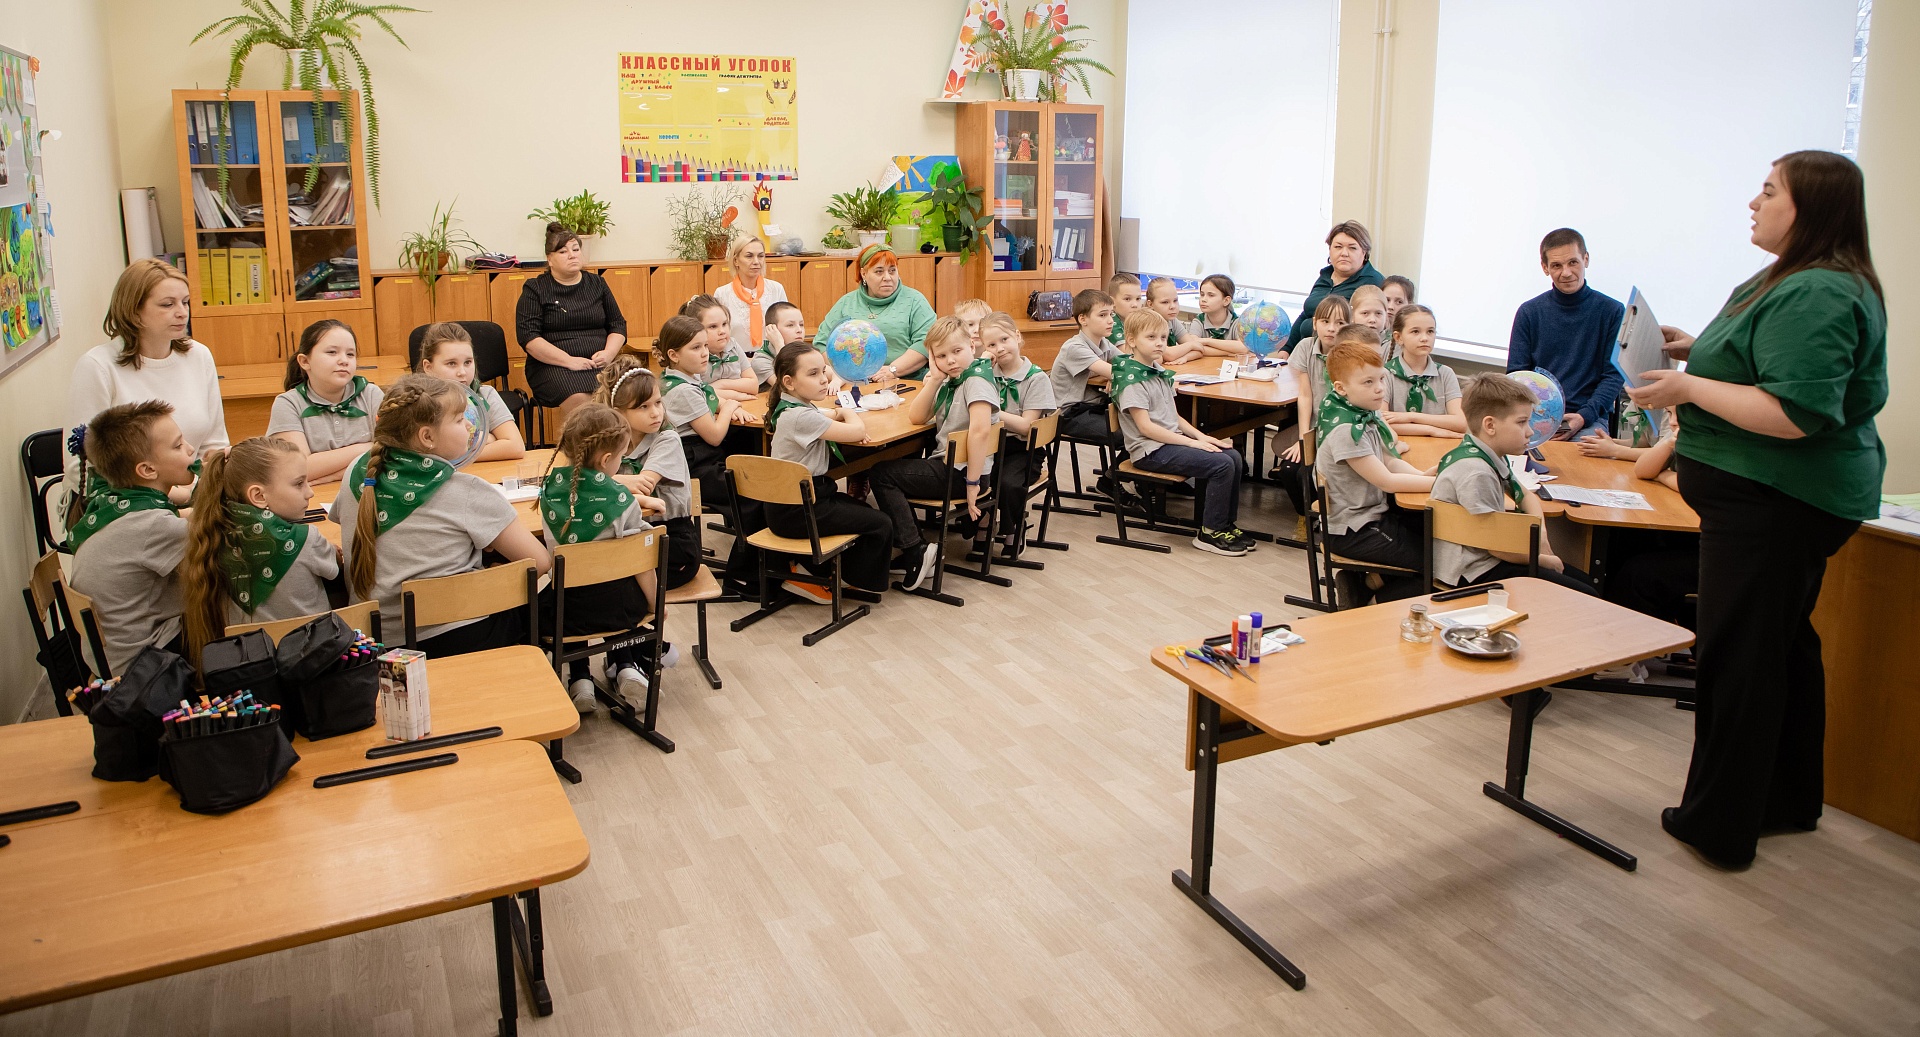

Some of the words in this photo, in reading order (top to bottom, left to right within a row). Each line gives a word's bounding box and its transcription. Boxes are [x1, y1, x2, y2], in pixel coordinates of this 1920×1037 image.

[621, 55, 721, 71] КЛАССНЫЙ
[729, 58, 791, 73] УГОЛОК
[1226, 363, 1233, 373] 2
[842, 394, 850, 405] 3
